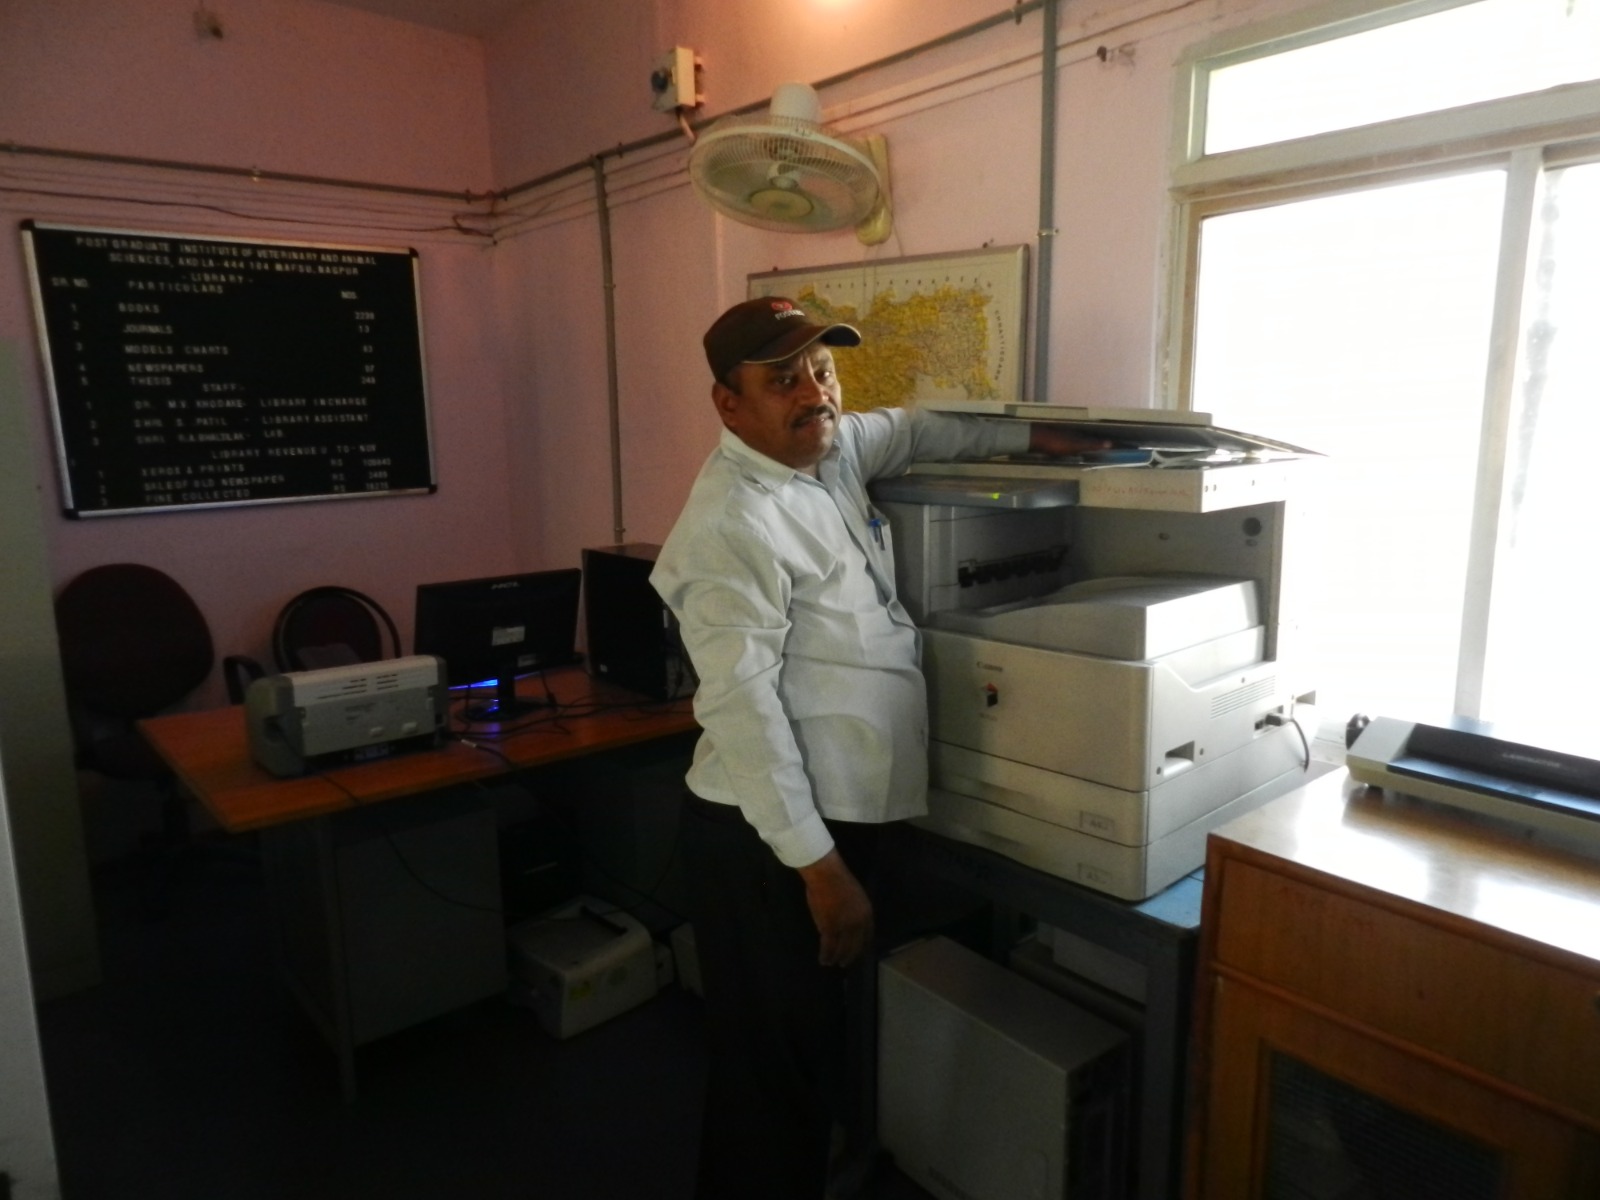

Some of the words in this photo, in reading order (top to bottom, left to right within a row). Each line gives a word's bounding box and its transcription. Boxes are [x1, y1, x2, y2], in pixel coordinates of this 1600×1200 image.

[76, 237, 107, 248] POST
[112, 239, 171, 252] GRADUATE
[179, 244, 238, 256] INSTITUTE
[241, 248, 252, 257] OF
[257, 249, 317, 260] VETERINARY
[321, 254, 339, 263] AND
[341, 256, 377, 265] ANIMAL
[128, 281, 224, 294] PARTICULARS
[118, 302, 160, 313] BOOKS
[124, 324, 173, 334] JOURNALS
[125, 345, 174, 355] MODELS
[185, 345, 229, 355] CHARTS
[128, 363, 204, 373] NEWSPAPERS
[130, 376, 172, 386] THESIS
[261, 398, 306, 408] LIBRARY
[262, 416, 309, 425] LIBRARY
[315, 413, 368, 423] ASSISTANT
[211, 449, 260, 460] LIBRARY
[200, 463, 245, 473] PRINTS
[222, 474, 285, 487] NEWSPAPER
[146, 494, 174, 503] FINE
[182, 488, 251, 501] COLLECTED
